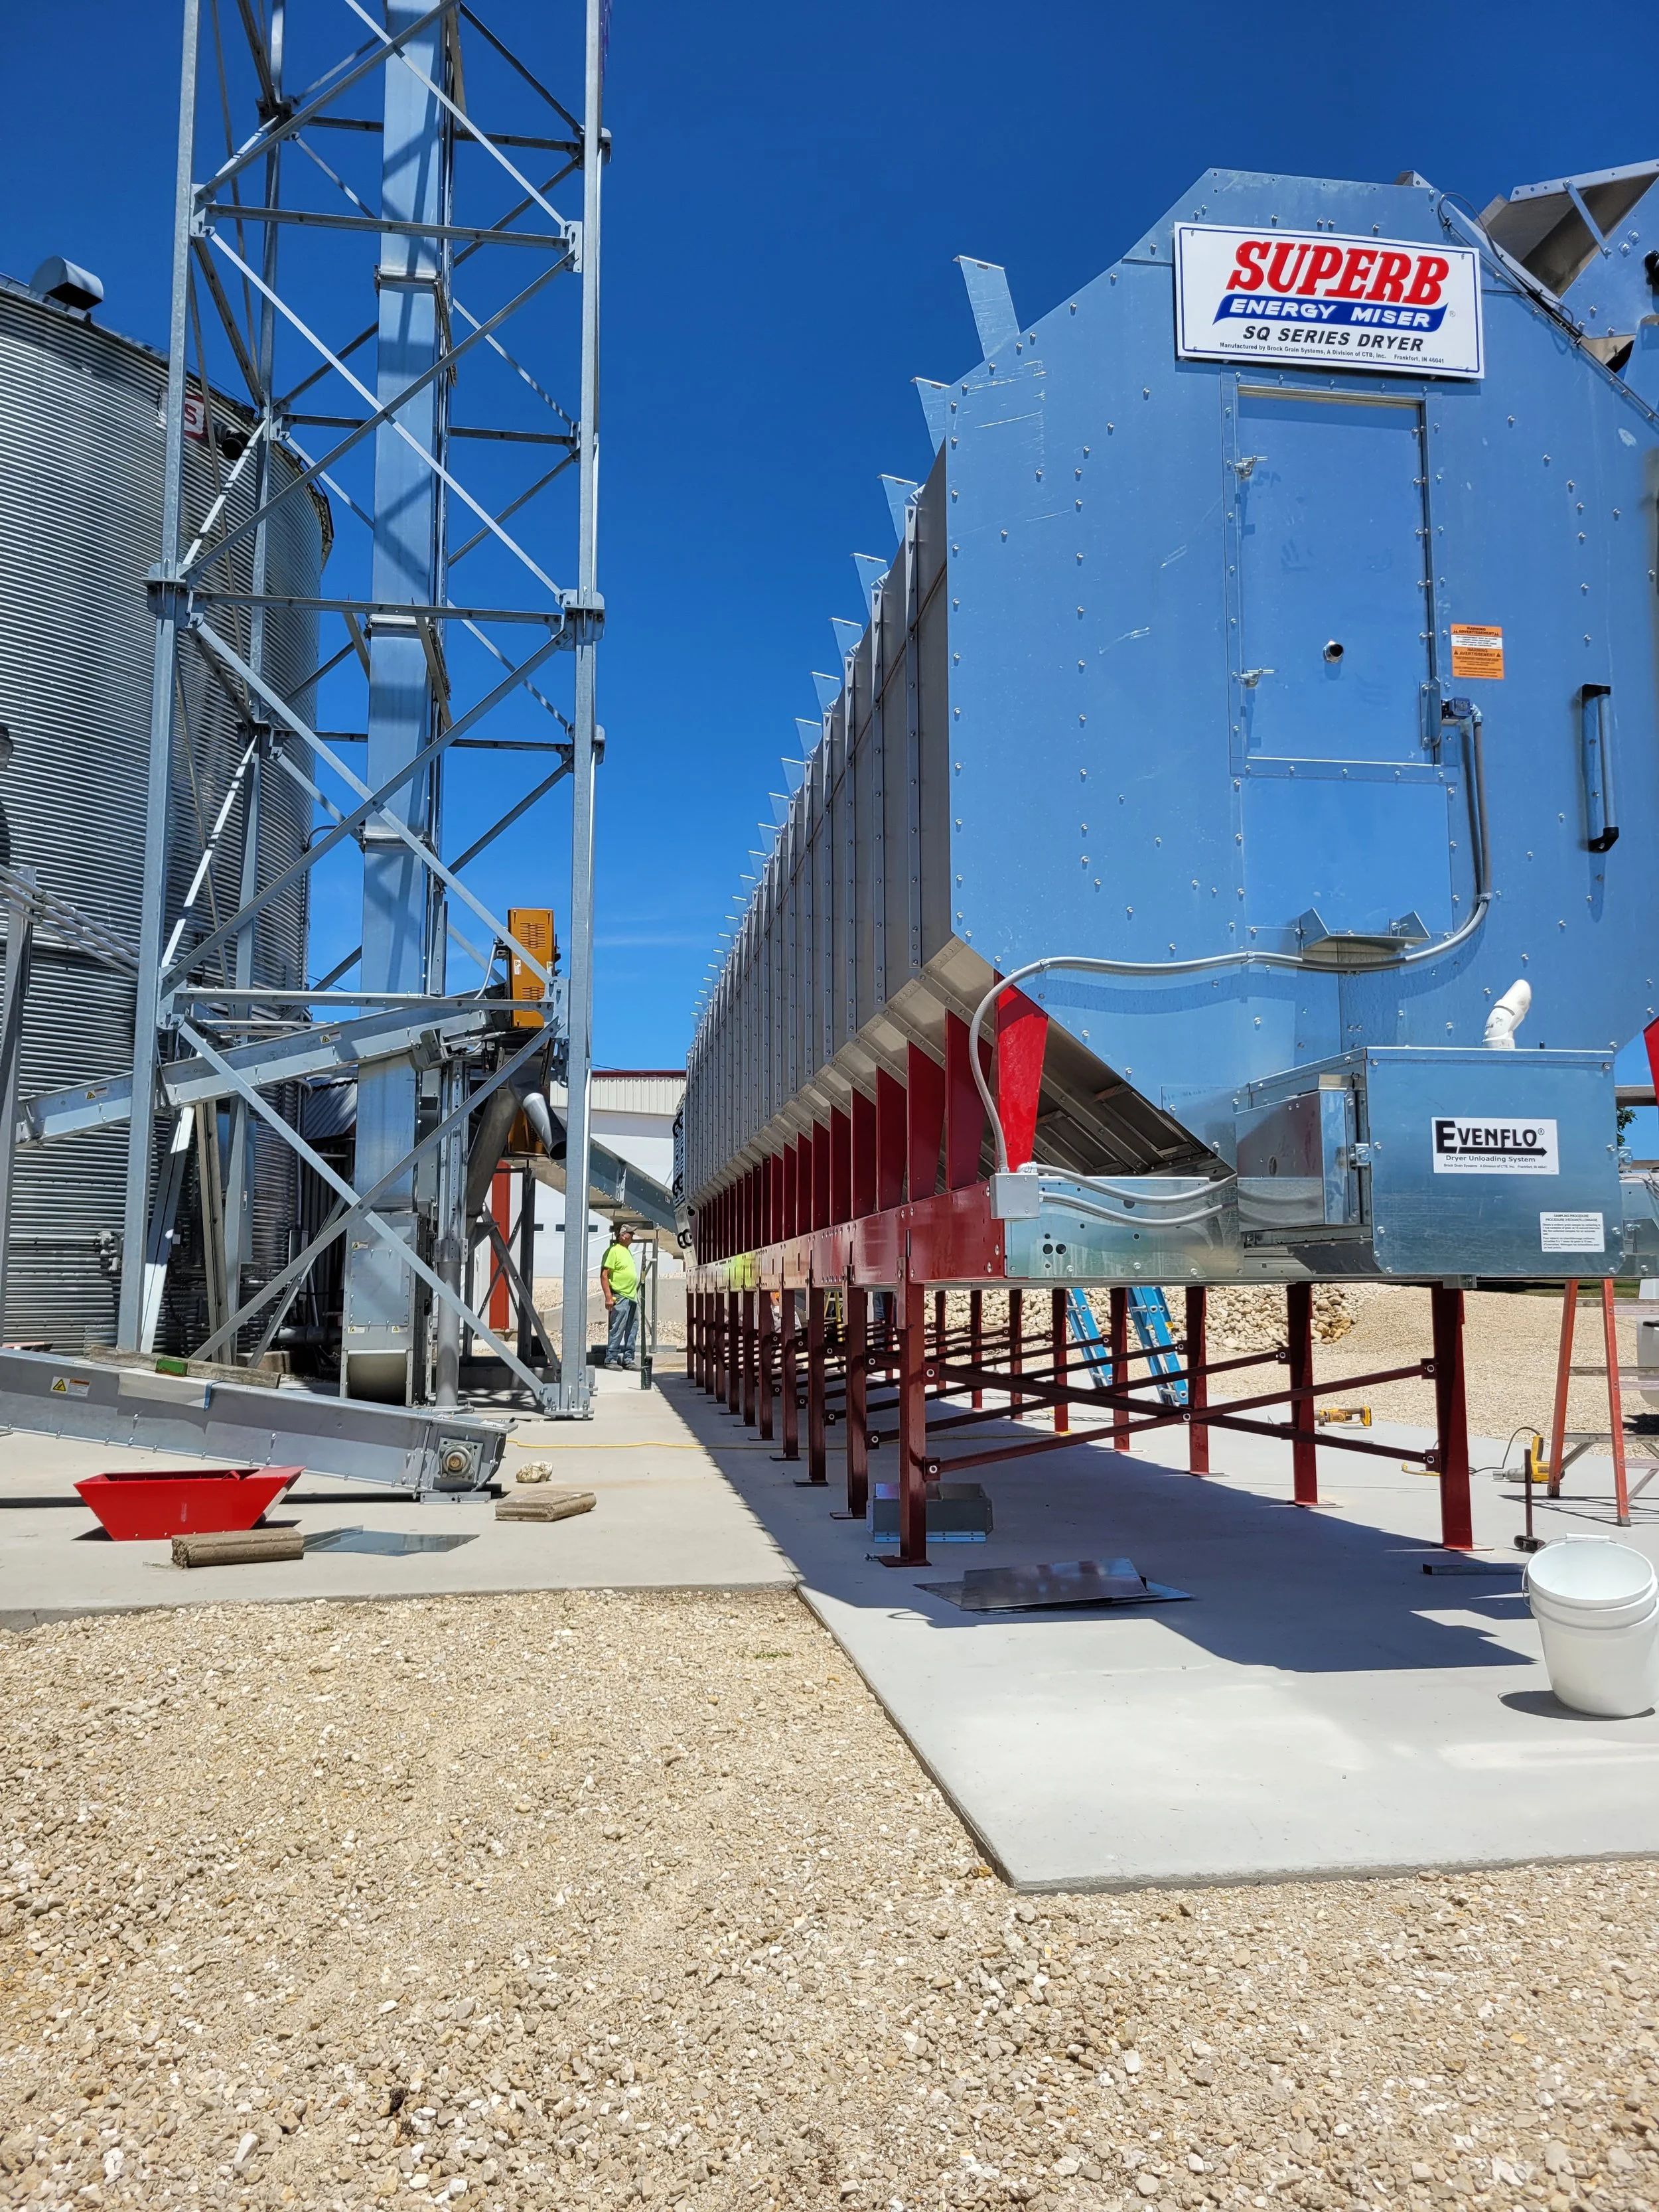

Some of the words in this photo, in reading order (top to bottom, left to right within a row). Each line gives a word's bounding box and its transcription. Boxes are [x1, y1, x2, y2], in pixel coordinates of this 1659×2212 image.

[1226, 240, 1449, 305] SUPERB
[1230, 298, 1337, 319] ENERGY
[1350, 307, 1430, 328] MISER
[1243, 325, 1270, 341] SQ
[1277, 328, 1350, 345] SERIES
[1357, 334, 1423, 352] DRYER
[1435, 1120, 1537, 1153] EVENFLO
